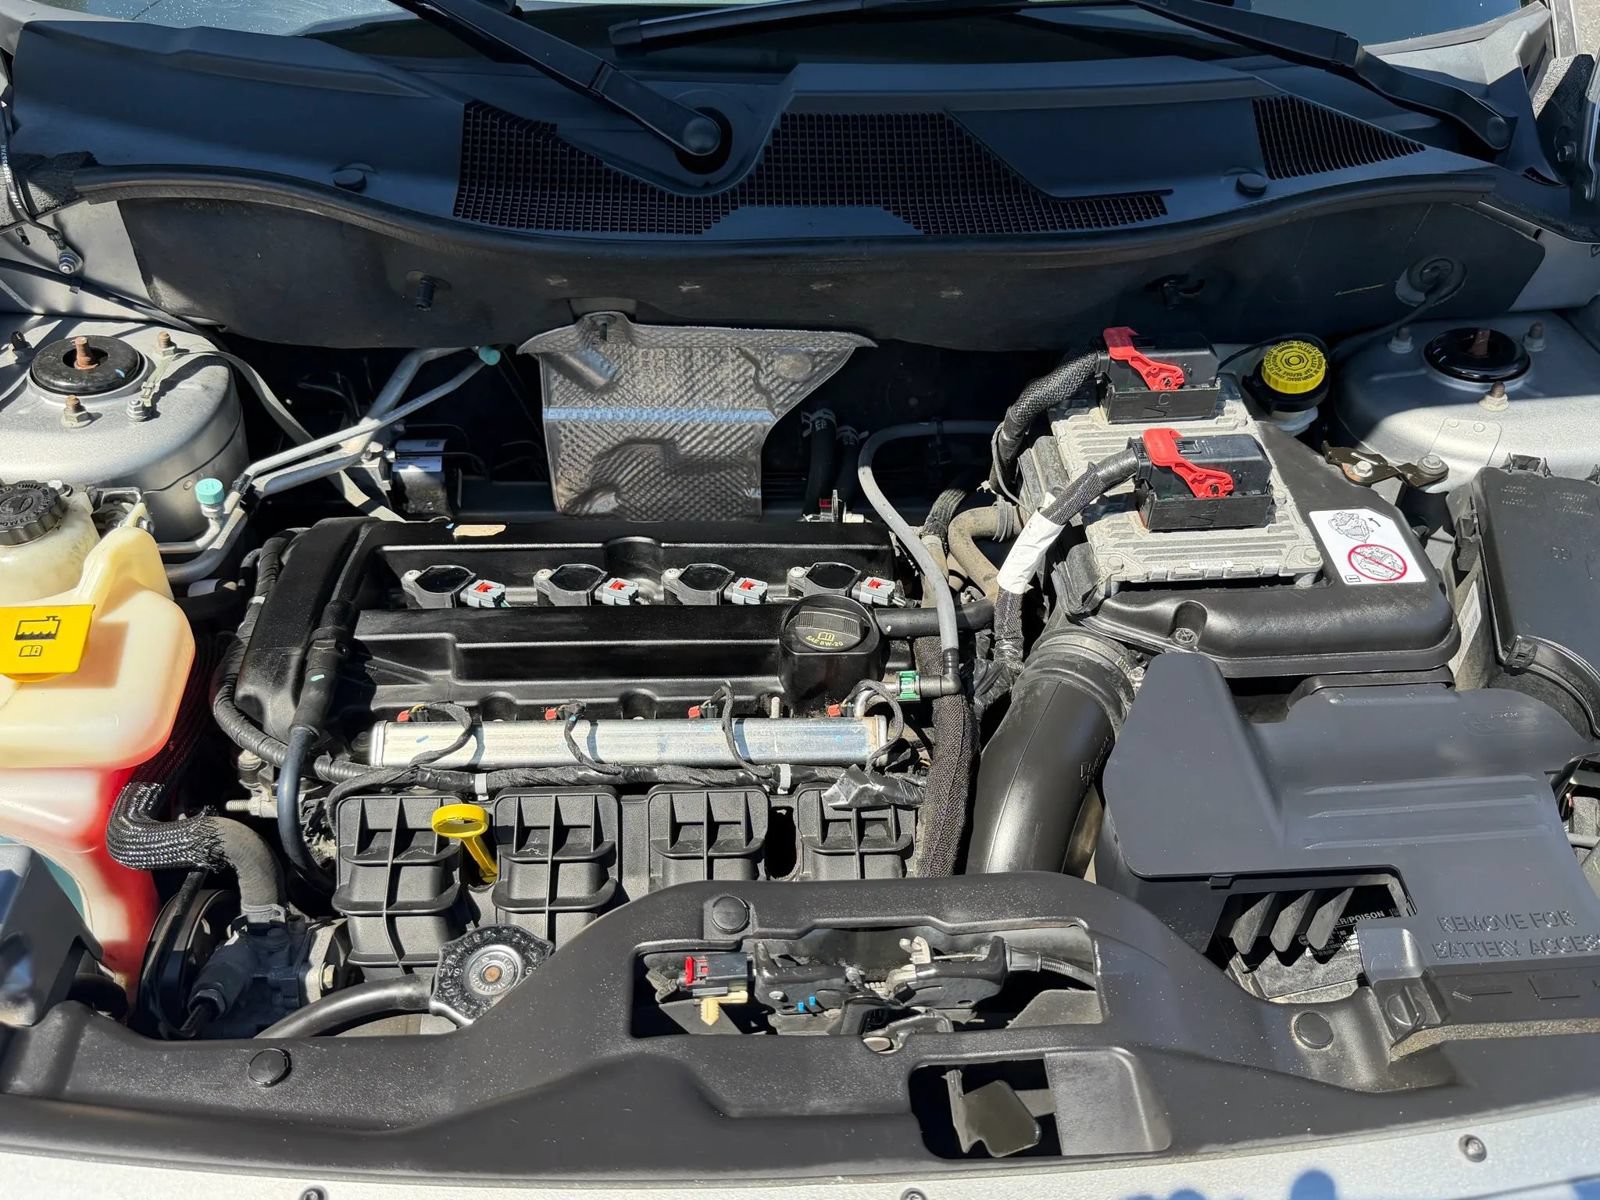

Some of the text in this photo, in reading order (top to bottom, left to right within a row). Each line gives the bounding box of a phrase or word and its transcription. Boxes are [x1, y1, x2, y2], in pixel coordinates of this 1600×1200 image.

[1437, 910, 1577, 933] REMOVE FOR
[1432, 939, 1522, 960] BATTERY
